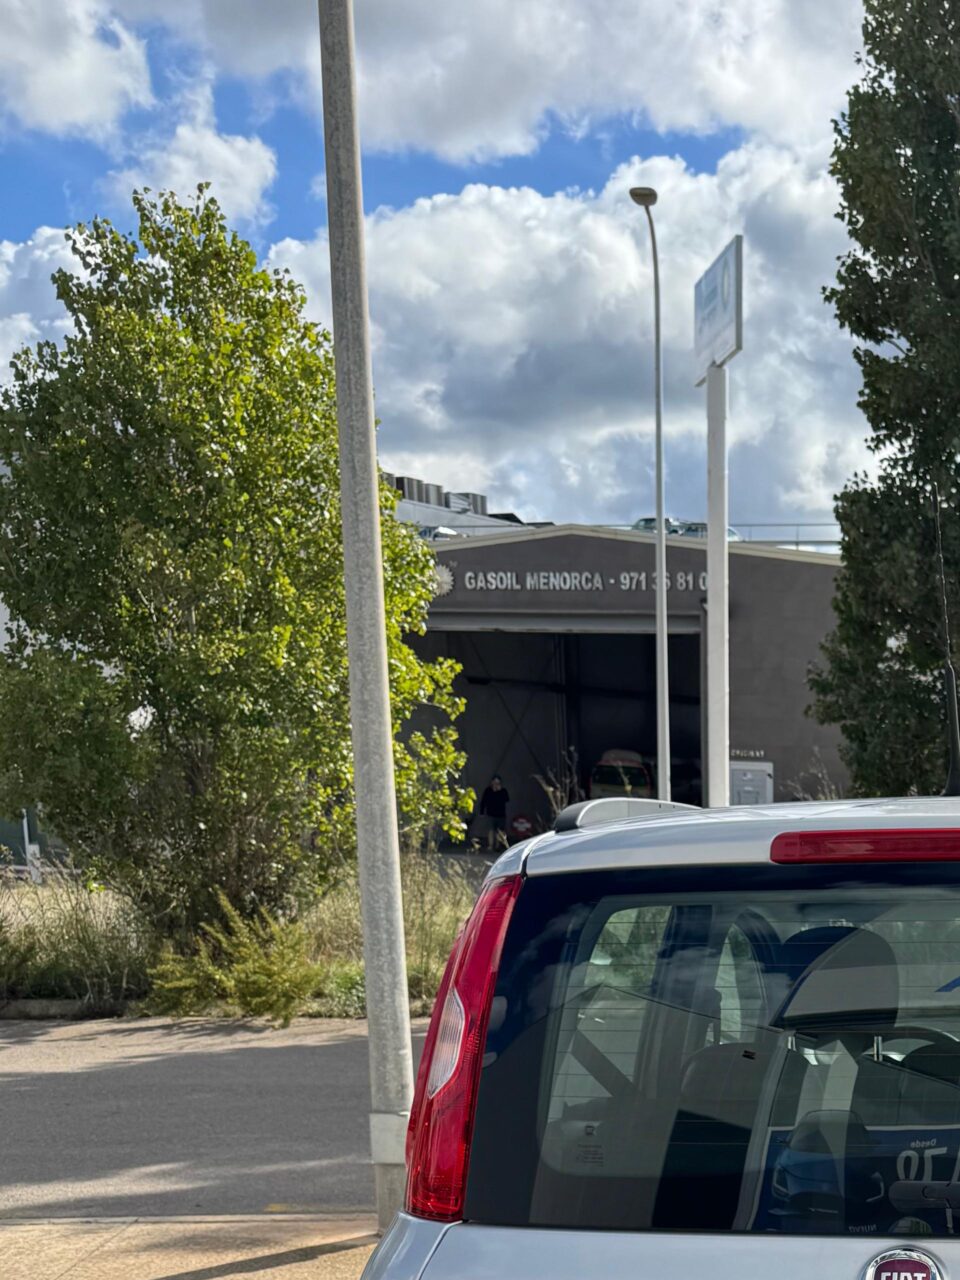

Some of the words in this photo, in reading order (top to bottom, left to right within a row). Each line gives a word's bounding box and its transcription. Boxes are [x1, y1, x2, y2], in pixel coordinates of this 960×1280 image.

[465, 572, 521, 591] GASOIL
[526, 572, 603, 591] MENORCA
[620, 572, 646, 591] 971
[677, 572, 694, 591] 81
